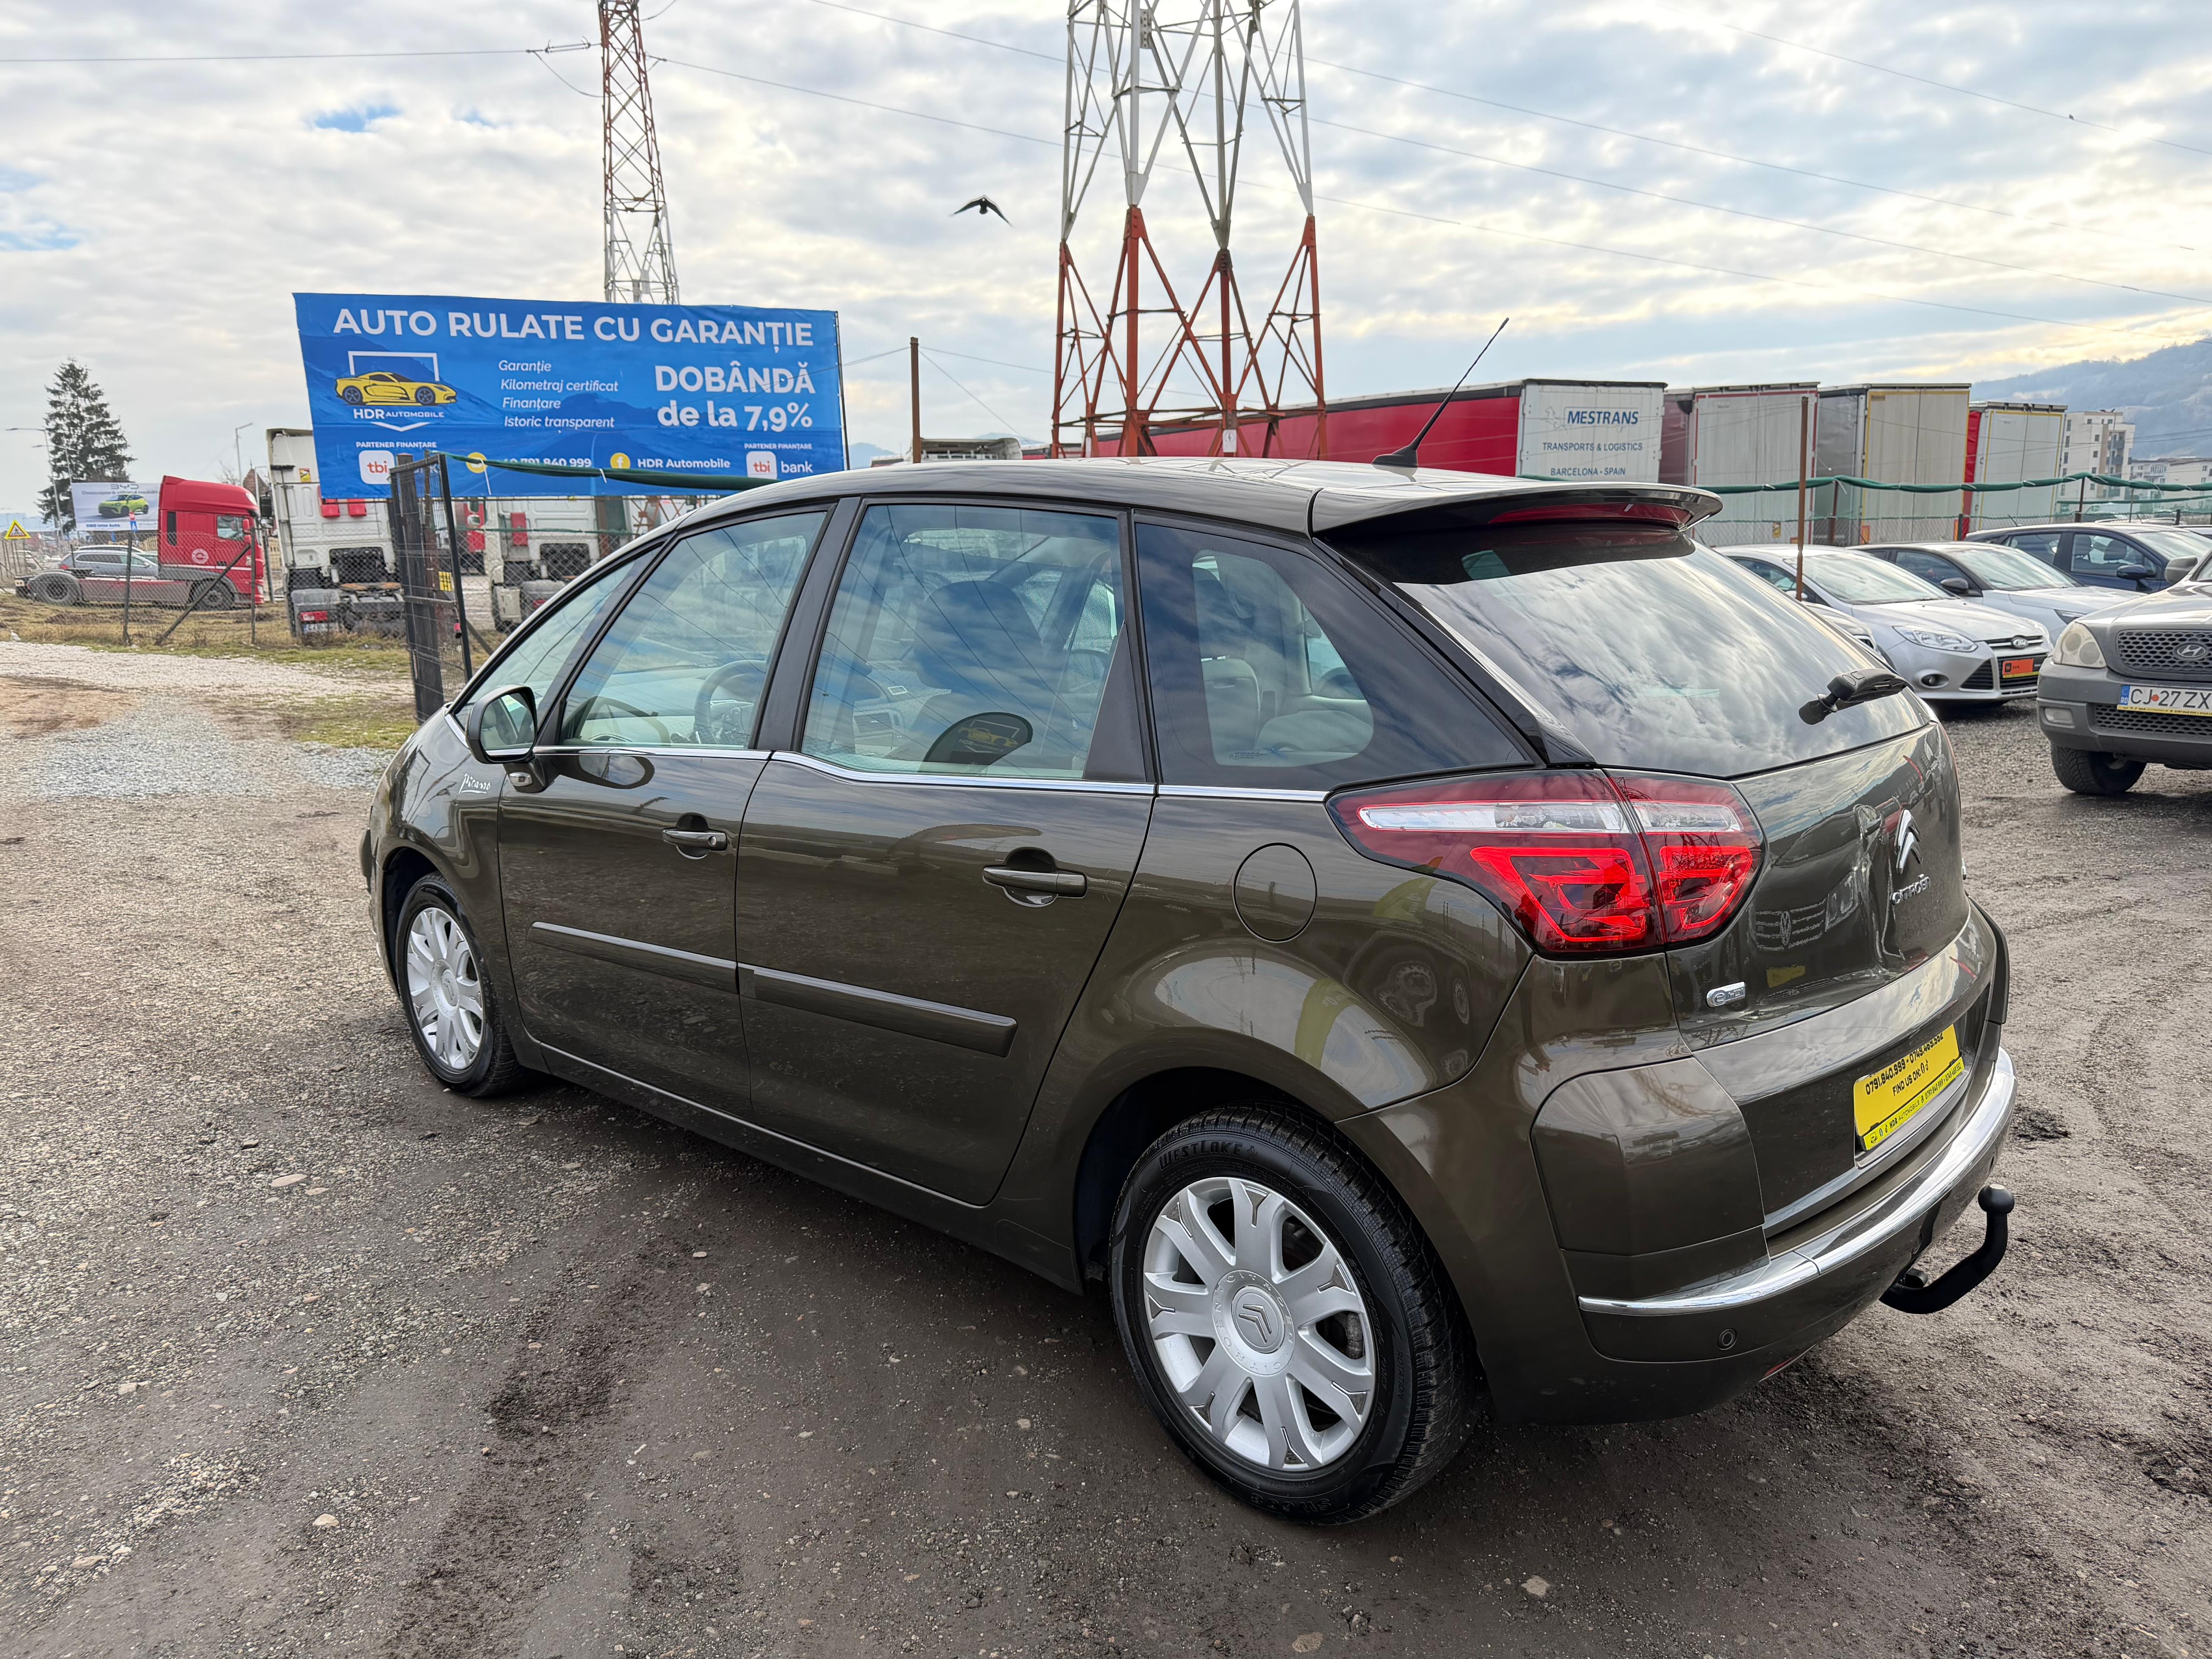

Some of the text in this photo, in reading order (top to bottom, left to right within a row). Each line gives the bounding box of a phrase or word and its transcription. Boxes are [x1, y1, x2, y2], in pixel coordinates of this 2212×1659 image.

[333, 308, 814, 353] AUTO RULATE CU GARANȚIE
[499, 359, 552, 374] Garanție
[654, 360, 816, 394] DOBÂNDĂ
[501, 378, 619, 393] Kilometraj certificat
[502, 397, 561, 411] Finanțare
[353, 408, 385, 419] HDR
[657, 400, 813, 432] de la 7,9%
[1567, 410, 1639, 425] MESTRANS
[504, 416, 615, 430] Istoric transparent
[1542, 442, 1643, 451] TRANSPORTS & LOGISTICS
[366, 461, 388, 474] tbi
[543, 458, 567, 467] 840
[569, 458, 592, 467] 999
[637, 458, 731, 468] HDR Automobile
[753, 460, 814, 474] tbi bank
[1551, 467, 1625, 476] BARCELONA SPAIN
[2130, 688, 2153, 705] CJ
[2158, 690, 2181, 707] 27
[1892, 1080, 1905, 1096] FIND
[1905, 1074, 1913, 1087] US
[1159, 1140, 1244, 1172] WESTLAKE
[1395, 1349, 1405, 1400] ROTATION
